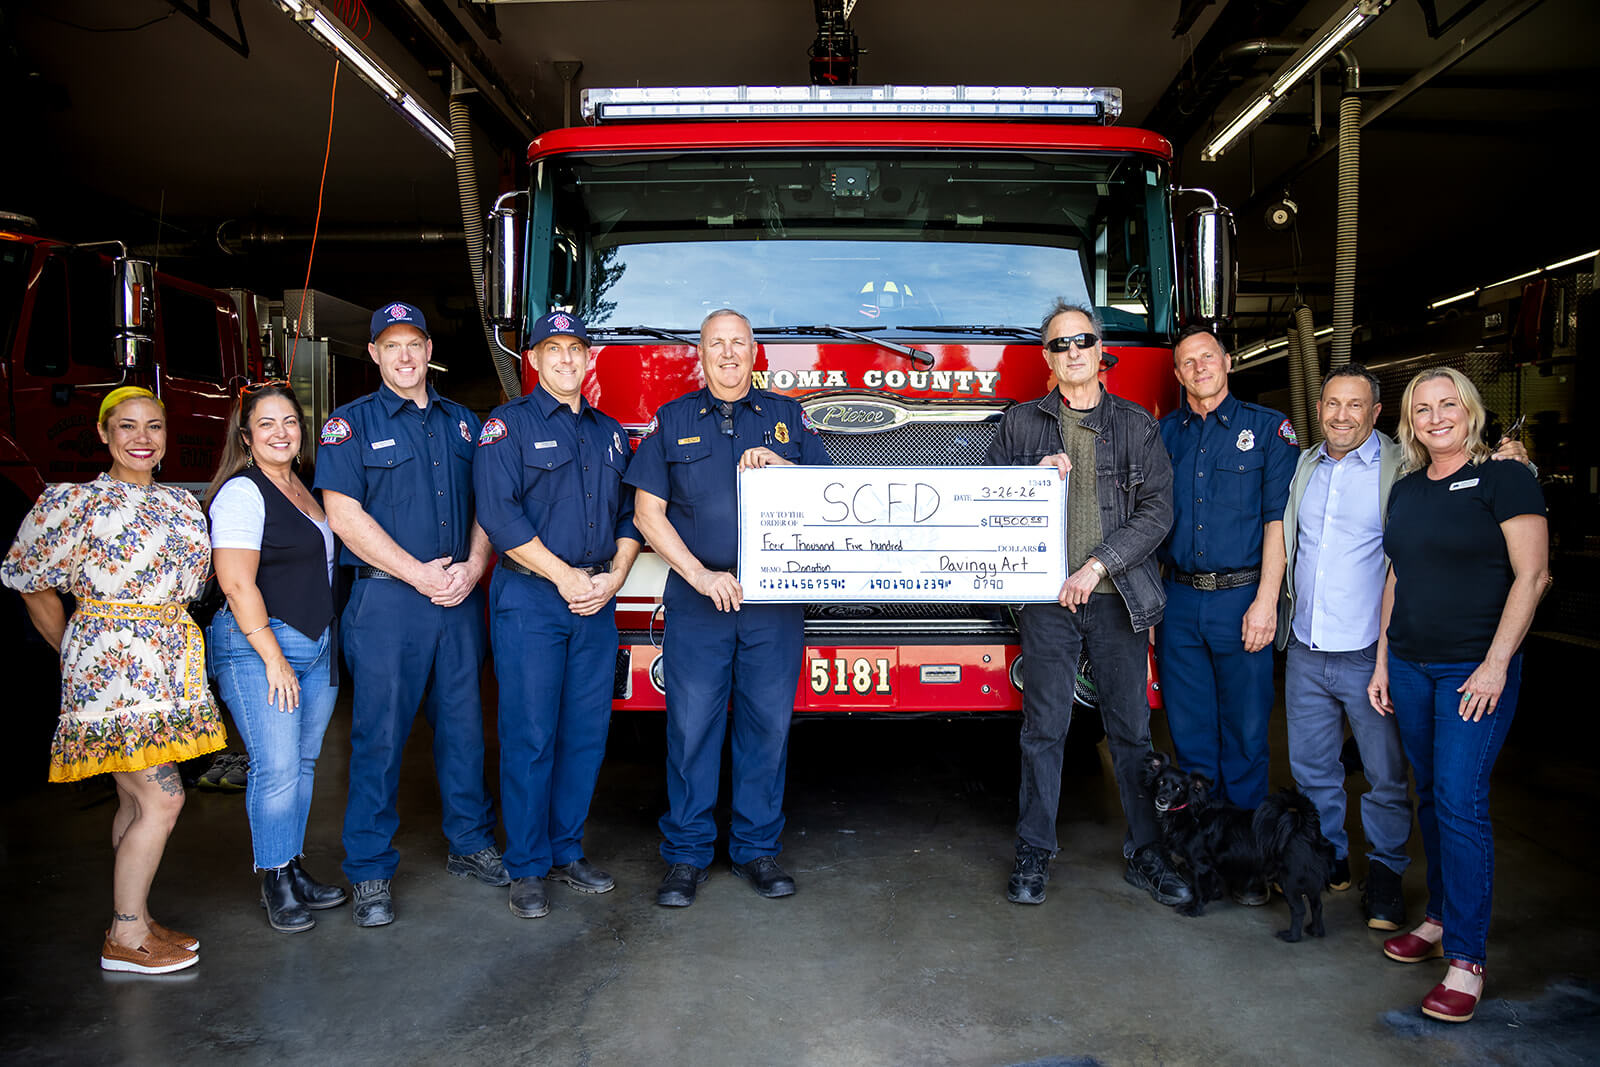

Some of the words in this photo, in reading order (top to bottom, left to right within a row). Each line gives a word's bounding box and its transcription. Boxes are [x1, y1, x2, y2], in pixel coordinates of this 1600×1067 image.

[752, 370, 848, 390] NOMA
[863, 370, 999, 394] COUNTY
[822, 406, 885, 425] Pierce
[981, 487, 1036, 498] 3-26-26
[822, 482, 940, 524] SCFD
[760, 511, 775, 519] PAY
[776, 511, 787, 519] TO
[788, 511, 805, 519] THE
[760, 519, 786, 527] ORDER
[787, 519, 799, 527] OF
[792, 533, 835, 551] Thousand
[845, 538, 863, 551] Five
[870, 540, 904, 552] hundred
[787, 561, 831, 573] Donation
[939, 555, 997, 579] Davingy
[1001, 556, 1029, 571] Art
[810, 658, 892, 694] 5181
